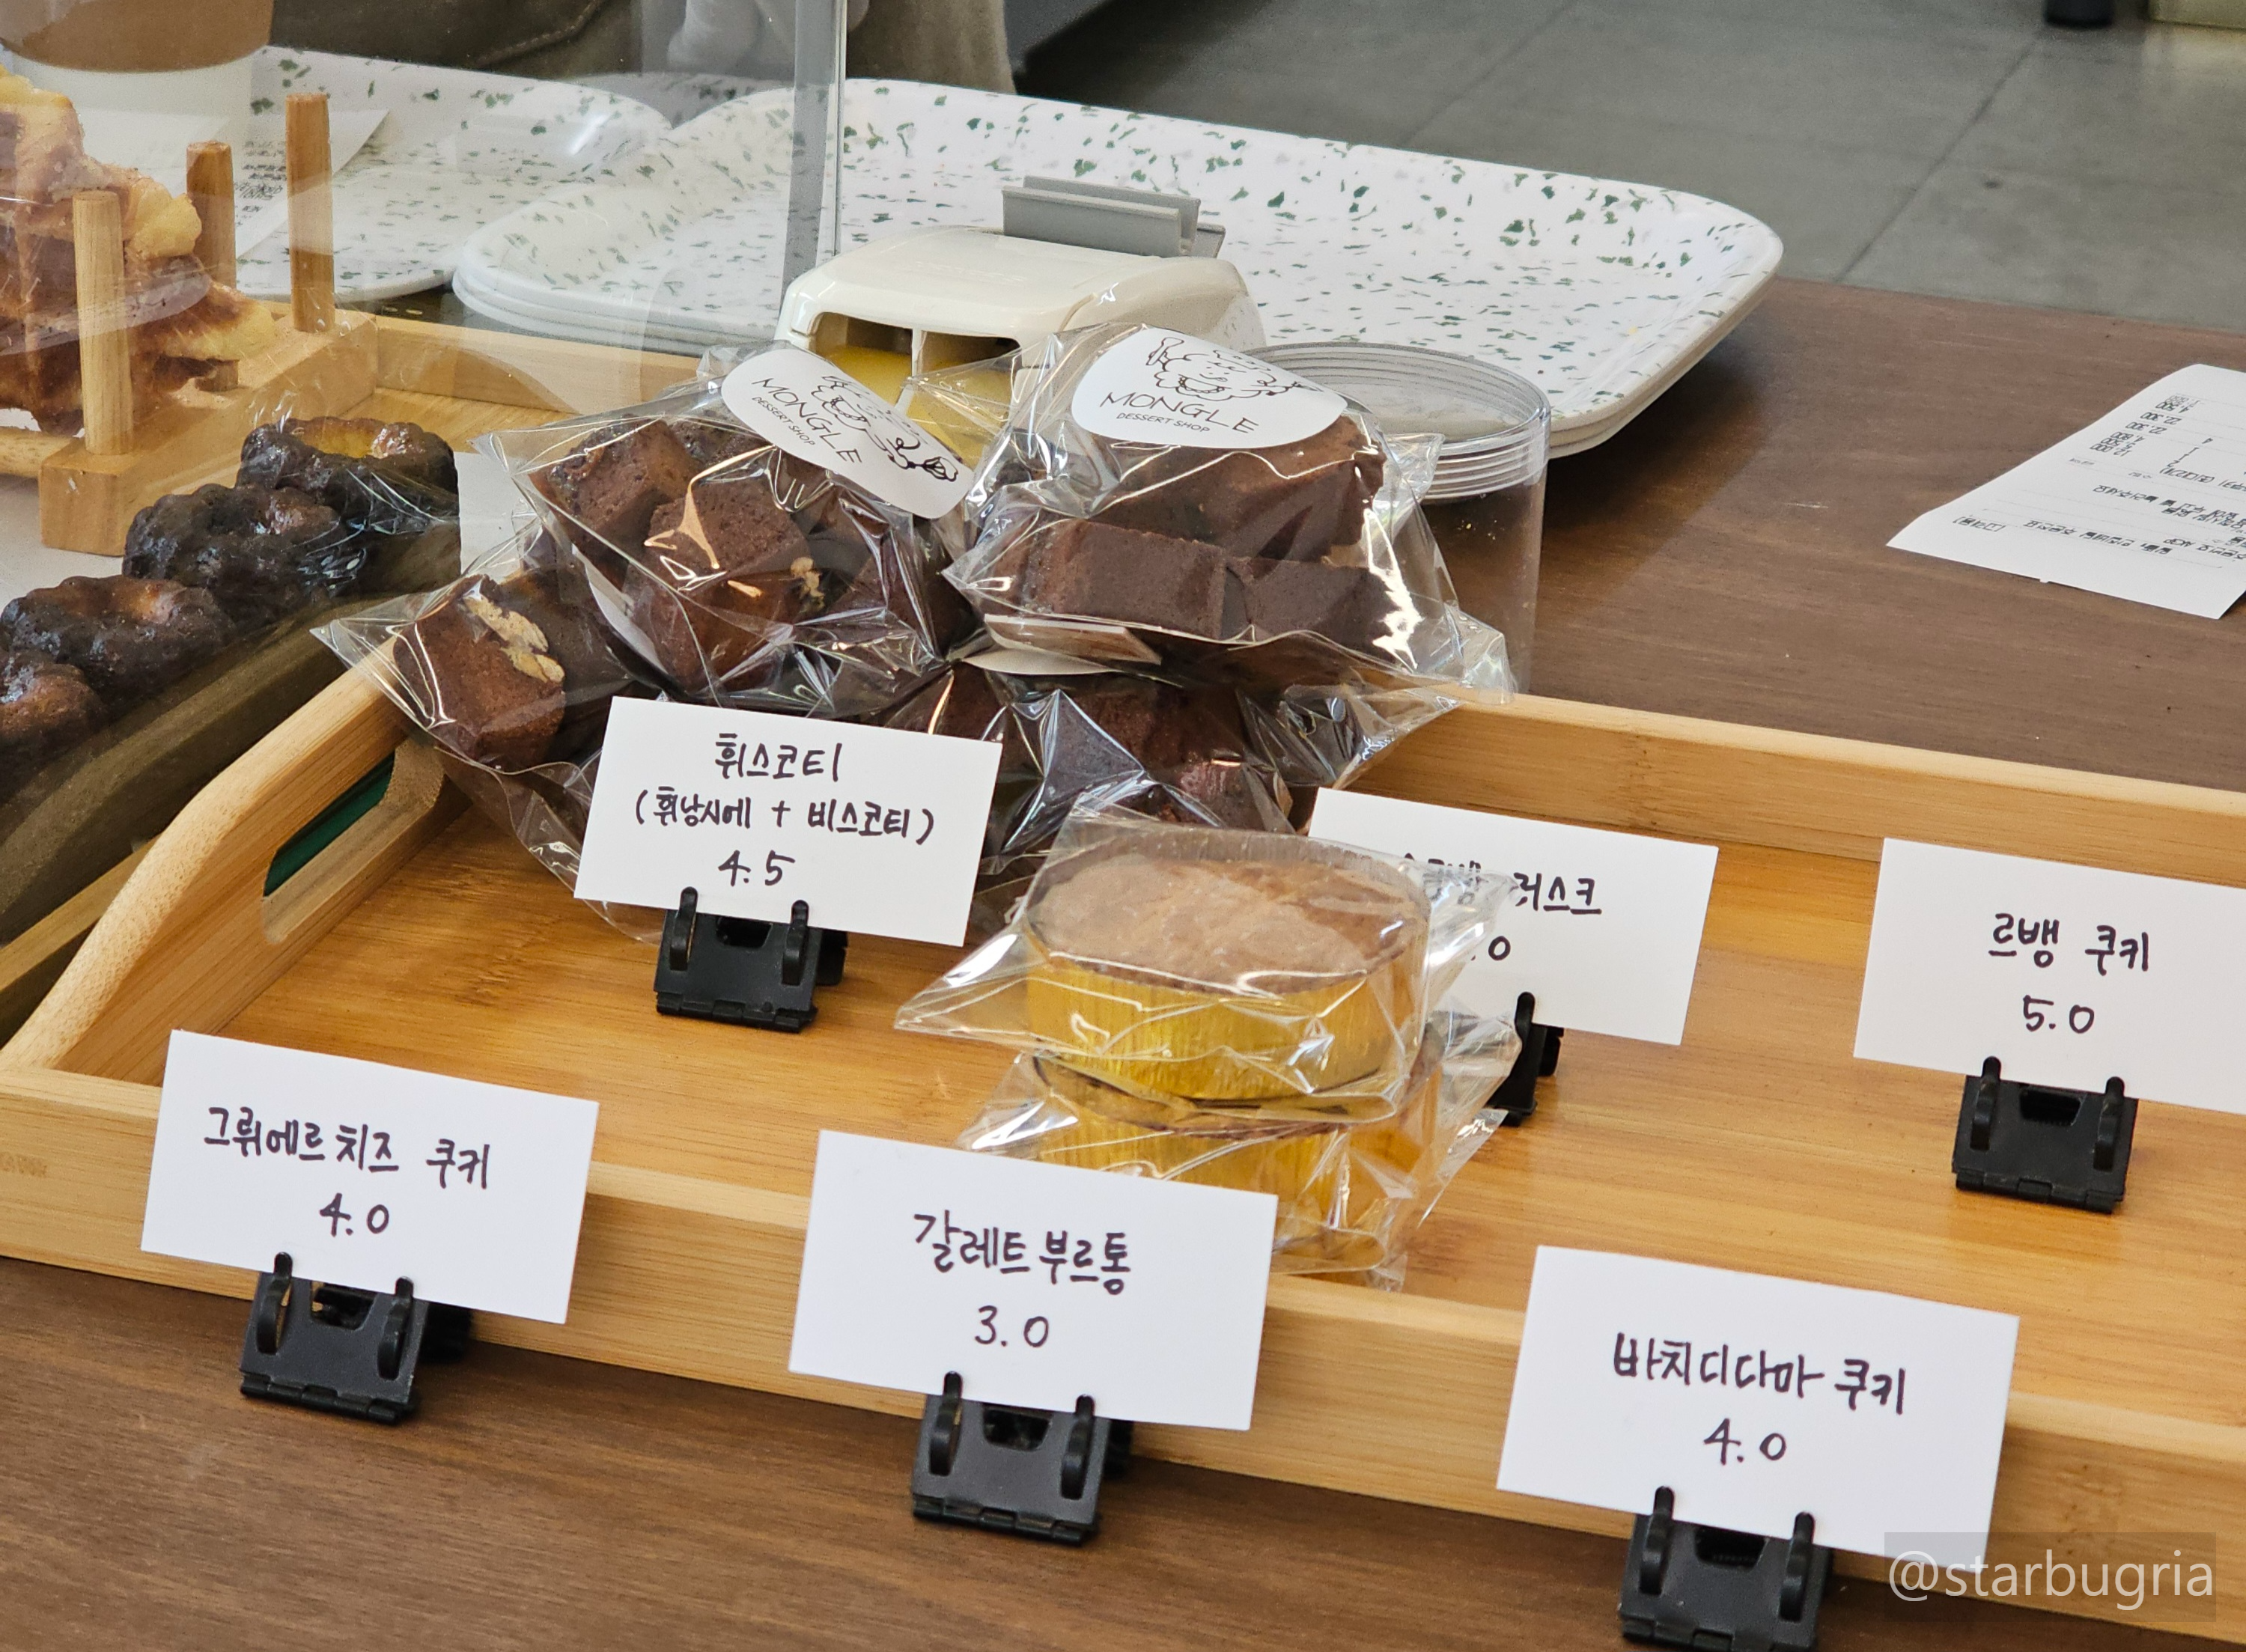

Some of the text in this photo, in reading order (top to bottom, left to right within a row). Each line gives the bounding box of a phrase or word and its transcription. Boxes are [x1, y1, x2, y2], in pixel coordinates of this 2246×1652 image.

[752, 377, 862, 463] MONGLE
[752, 396, 815, 445] DESSERT SHOP
[1099, 391, 1260, 434] MONGLE
[1116, 412, 1211, 433] DESSERT SHOP
[715, 733, 842, 782] 휘스코티
[636, 786, 934, 845] (휘낭시에 + 비스코티)
[718, 850, 796, 887] 4.5
[1513, 872, 1602, 915] 러스크
[1988, 912, 2149, 976] 르뱅 쿠키
[2022, 994, 2095, 1034] 5.0
[426, 1139, 490, 1189] 쿠키
[320, 1192, 389, 1237] 4.0
[975, 1305, 1049, 1348] 3.0
[1613, 1332, 1905, 1415] 바치디다마 쿠키
[1703, 1418, 1786, 1466] 4.0
